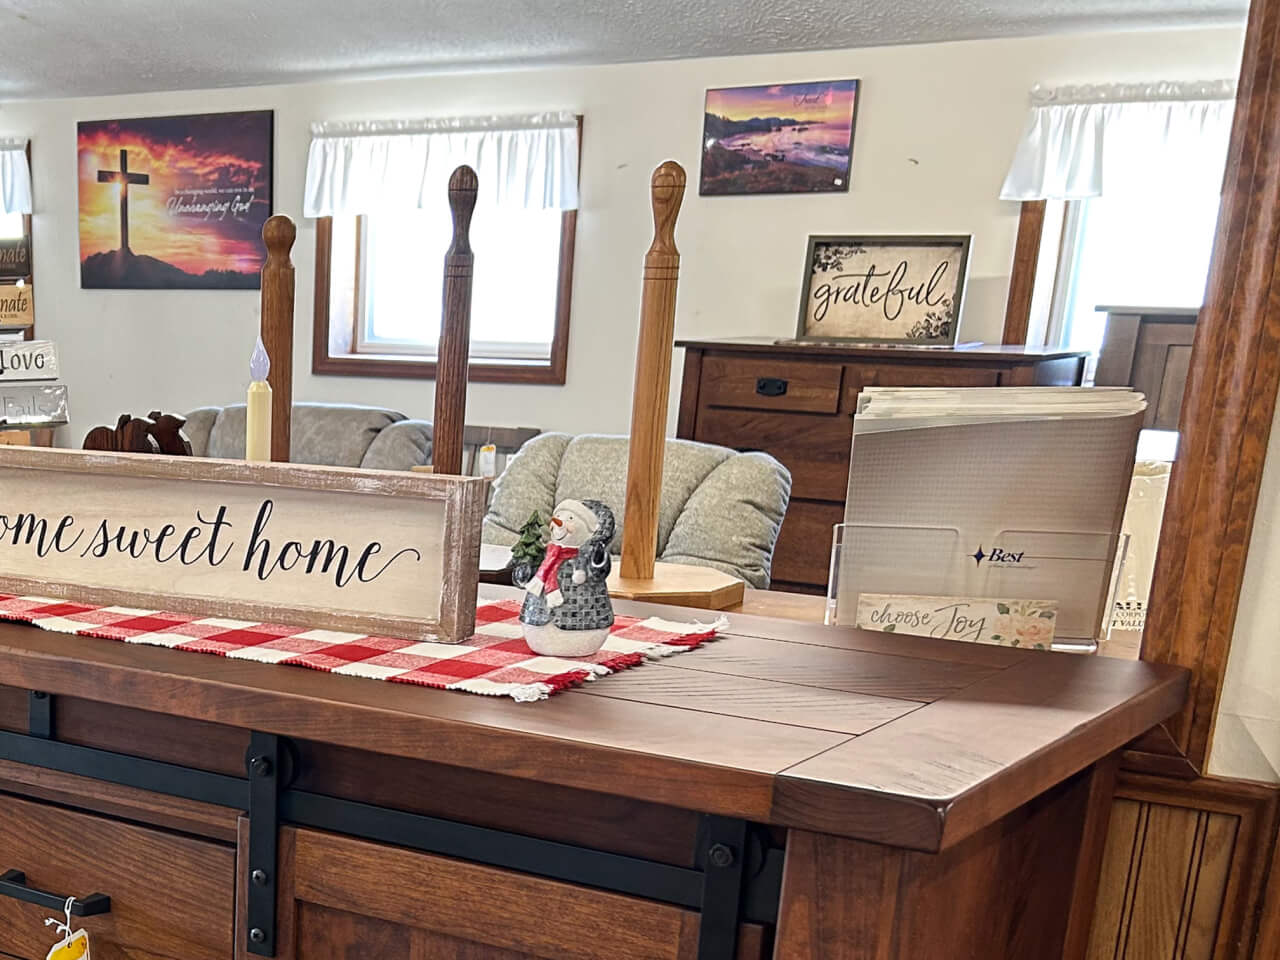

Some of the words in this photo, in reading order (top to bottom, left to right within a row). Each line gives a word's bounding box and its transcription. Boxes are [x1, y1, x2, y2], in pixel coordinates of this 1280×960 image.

[813, 260, 949, 322] grateful
[0, 350, 45, 370] Love
[3, 396, 45, 417] Fails
[80, 505, 234, 568] sweet
[243, 499, 420, 588] home
[988, 548, 1024, 562] Best
[871, 603, 932, 627] choose
[930, 603, 987, 640] Joy
